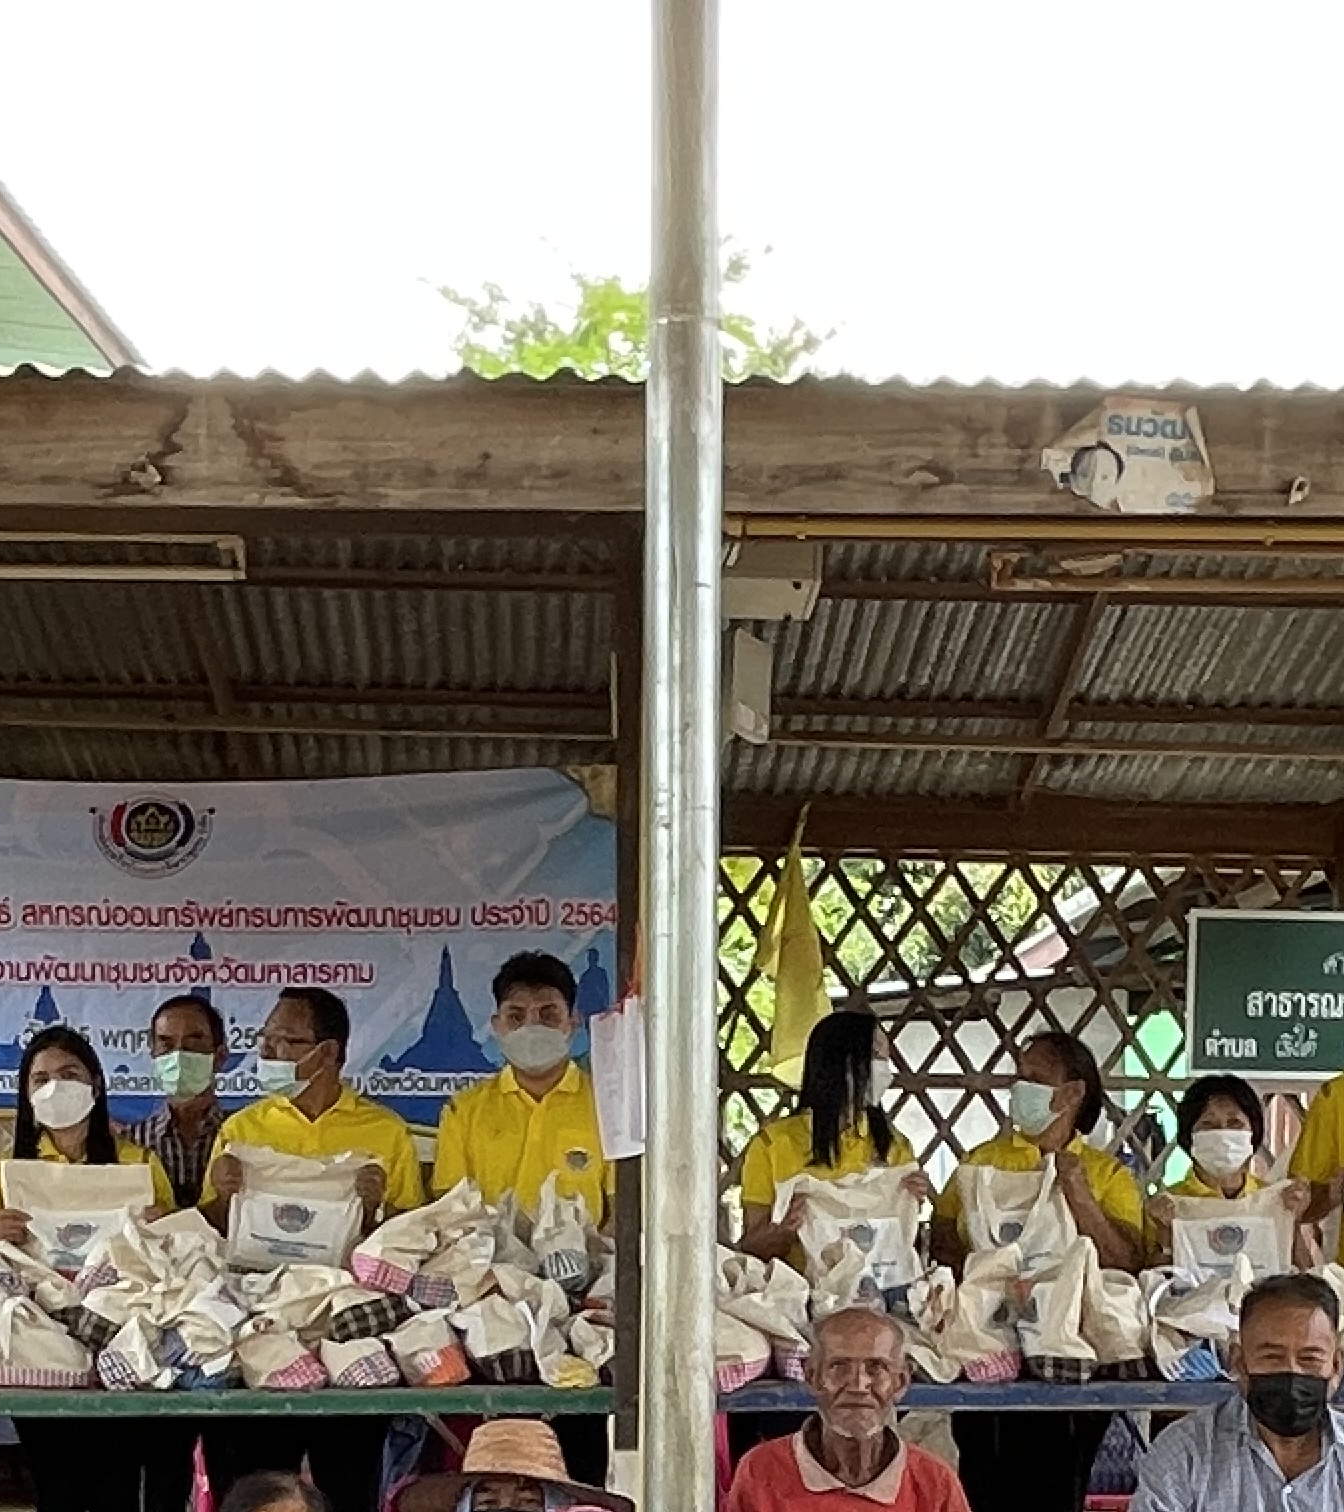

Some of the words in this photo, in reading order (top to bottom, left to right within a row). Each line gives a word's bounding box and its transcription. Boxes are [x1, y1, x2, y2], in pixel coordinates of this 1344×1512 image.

[471, 898, 550, 926] ประจำปี
[559, 902, 618, 926] 2564
[229, 1026, 258, 1050] 25
[1204, 1028, 1258, 1058] ตำบล
